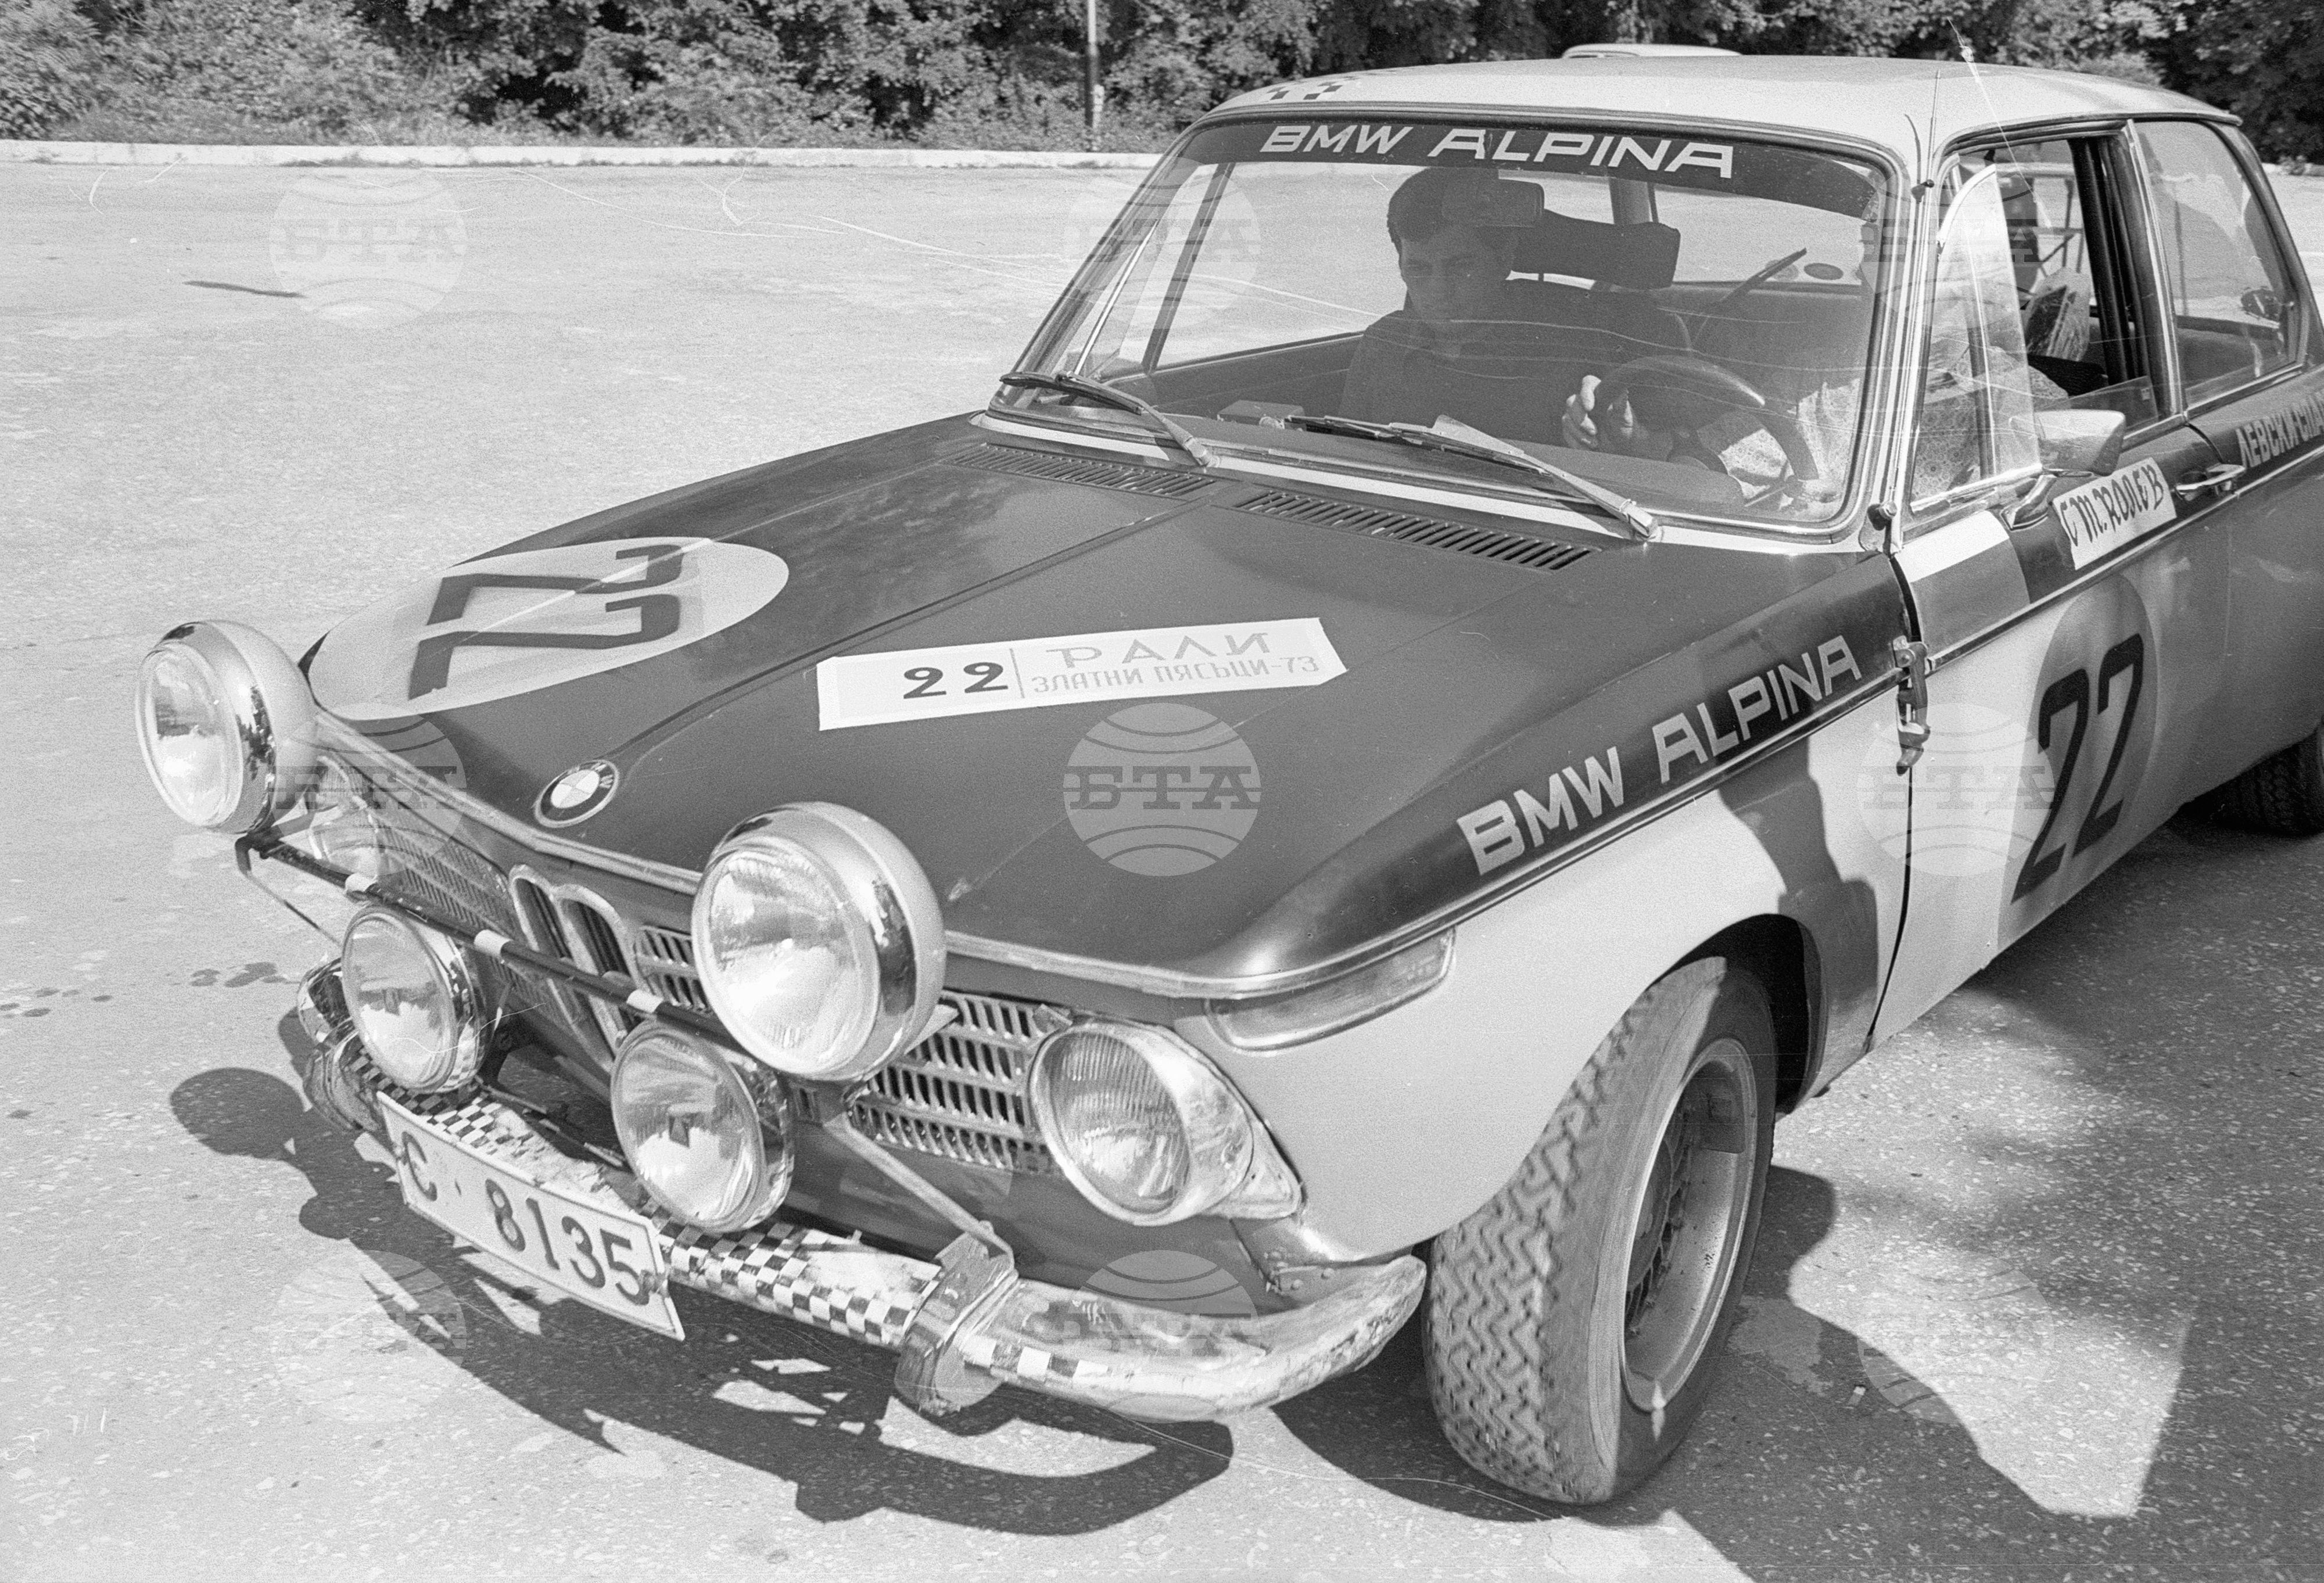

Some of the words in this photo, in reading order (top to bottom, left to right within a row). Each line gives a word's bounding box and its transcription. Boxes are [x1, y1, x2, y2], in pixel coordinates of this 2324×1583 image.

[1260, 125, 1413, 155] BMW
[1428, 128, 1734, 179] ALPINA
[1045, 632, 1271, 669] РАЛИ
[903, 662, 1009, 699] 22
[1031, 667, 1145, 694] ЗЛАТНИ
[1456, 746, 1624, 876] BMW
[1652, 634, 1862, 784] ALPINA
[2010, 633, 2144, 905] 22
[485, 1179, 650, 1306] 8135
